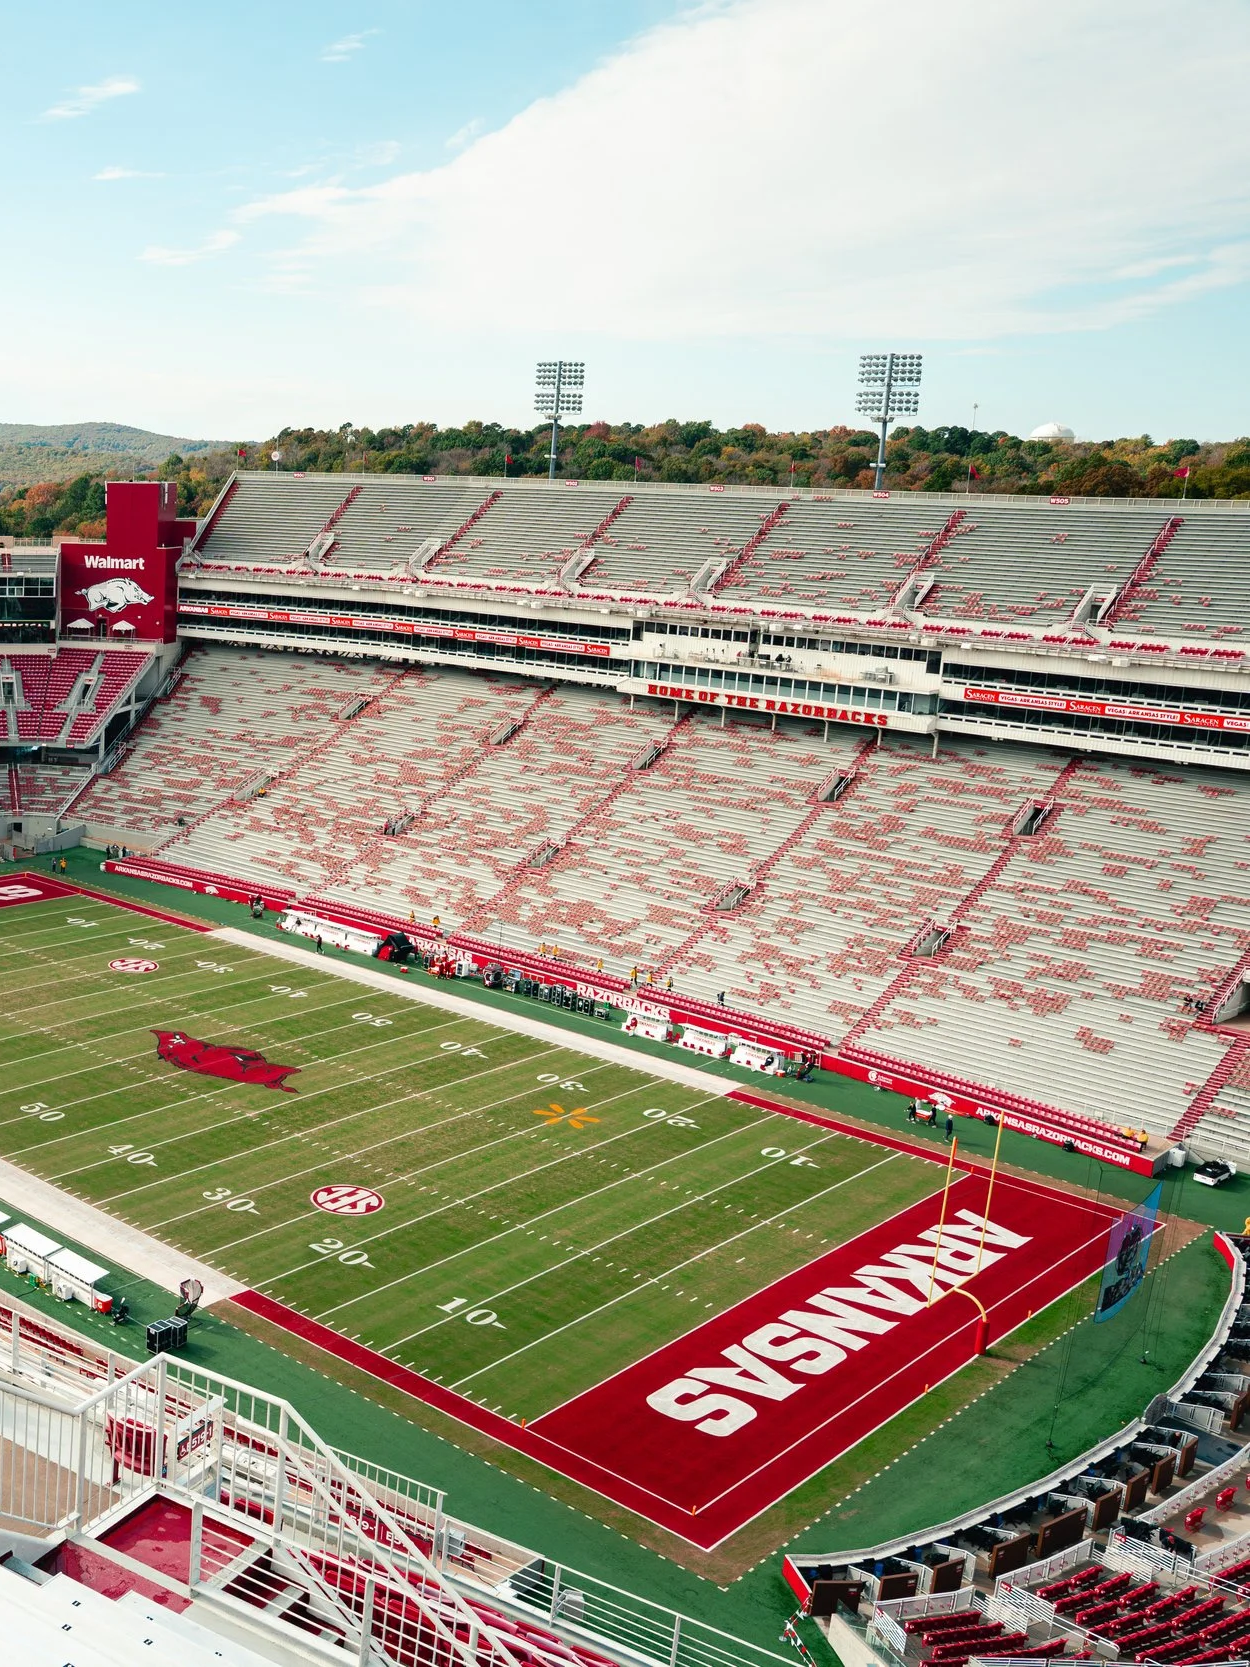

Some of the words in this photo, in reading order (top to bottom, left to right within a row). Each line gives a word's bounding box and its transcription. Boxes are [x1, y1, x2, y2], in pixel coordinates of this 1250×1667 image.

[84, 555, 145, 570] Walmart
[586, 645, 608, 654] SARACEN
[966, 689, 995, 699] SARACEN
[647, 684, 694, 699] HOME
[698, 691, 720, 703] OF
[724, 694, 759, 709] THE
[764, 699, 888, 726] RAZORBACKS
[1069, 701, 1101, 711] SARACEN
[1183, 714, 1219, 724] SARACEN
[114, 865, 193, 888] ARKANSASRAZORBACKS.COM
[132, 938, 166, 950] 20
[198, 960, 234, 974] 30
[270, 984, 308, 998] 40
[576, 983, 671, 1019] RAZORBACKS
[352, 1012, 394, 1028] 50
[440, 1042, 484, 1059] 40
[536, 1073, 582, 1090] 30
[20, 1101, 65, 1122] 50
[643, 1108, 694, 1129] 20
[107, 1143, 154, 1165] 40
[760, 1147, 813, 1168] 10
[202, 1187, 255, 1213] 30
[313, 1186, 382, 1214] SEC
[308, 1238, 370, 1265] 20
[436, 1297, 498, 1326] 10
[647, 1208, 1033, 1437] ARKANSAS
